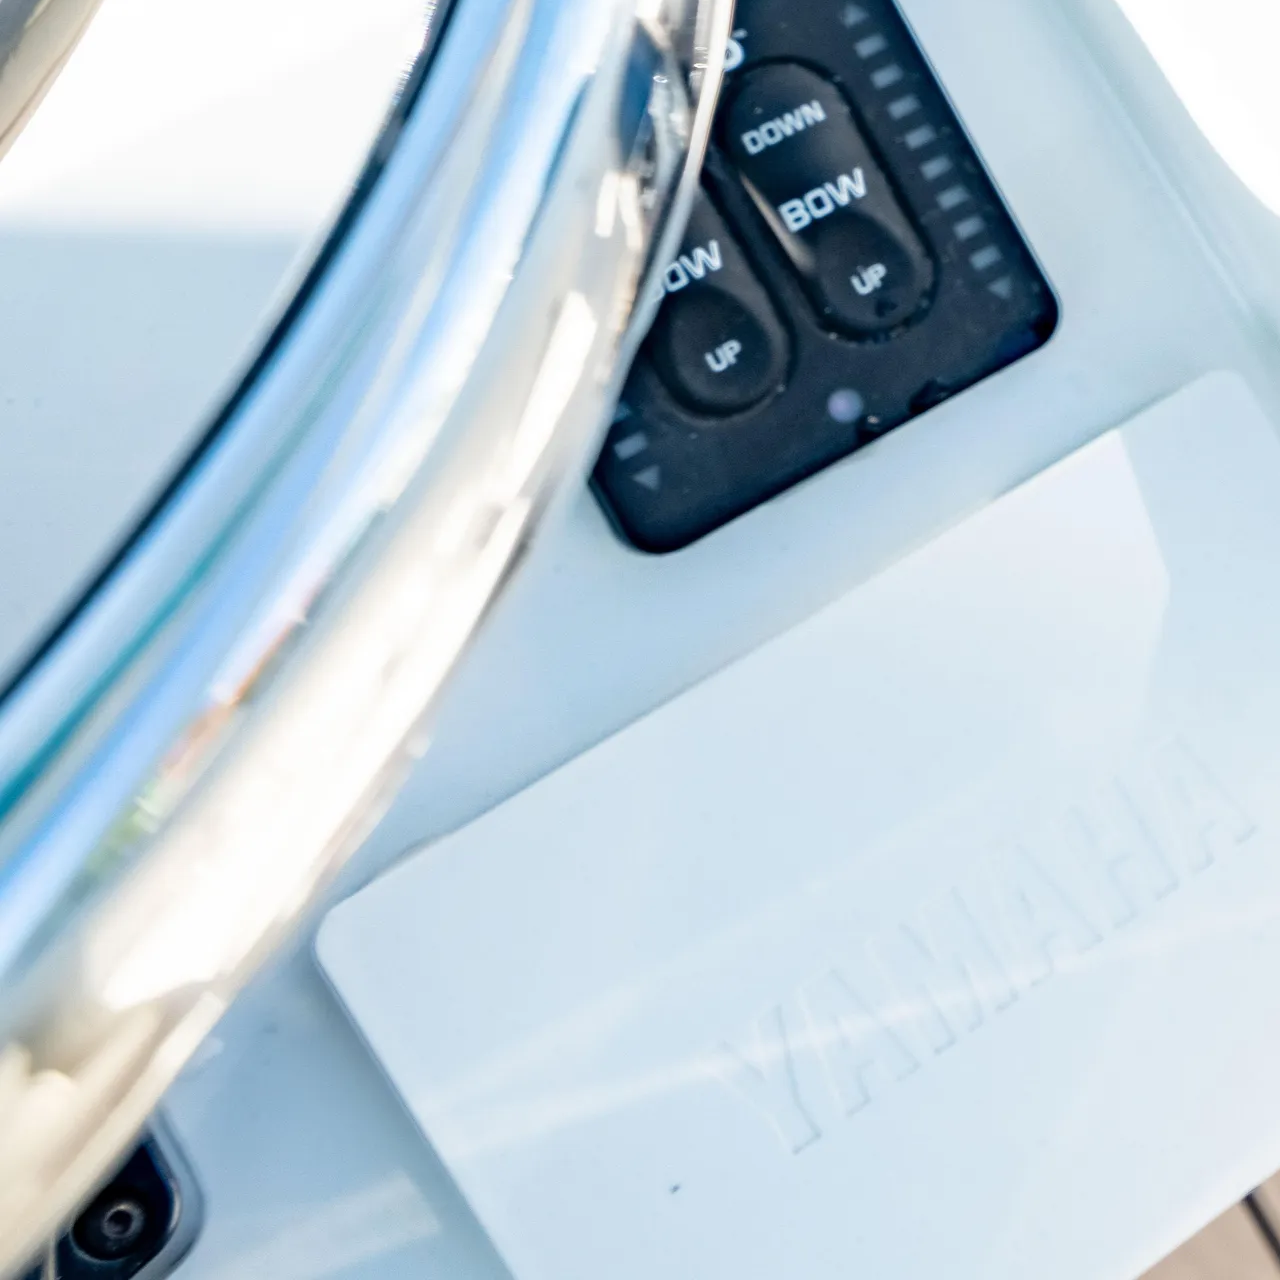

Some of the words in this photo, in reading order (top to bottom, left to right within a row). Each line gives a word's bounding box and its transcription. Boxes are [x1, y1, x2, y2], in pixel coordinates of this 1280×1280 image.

[740, 99, 828, 155] DOWN
[778, 167, 868, 233] BOW
[850, 262, 888, 296] UP
[704, 338, 742, 373] UP
[706, 734, 1259, 1155] YAMAHA
